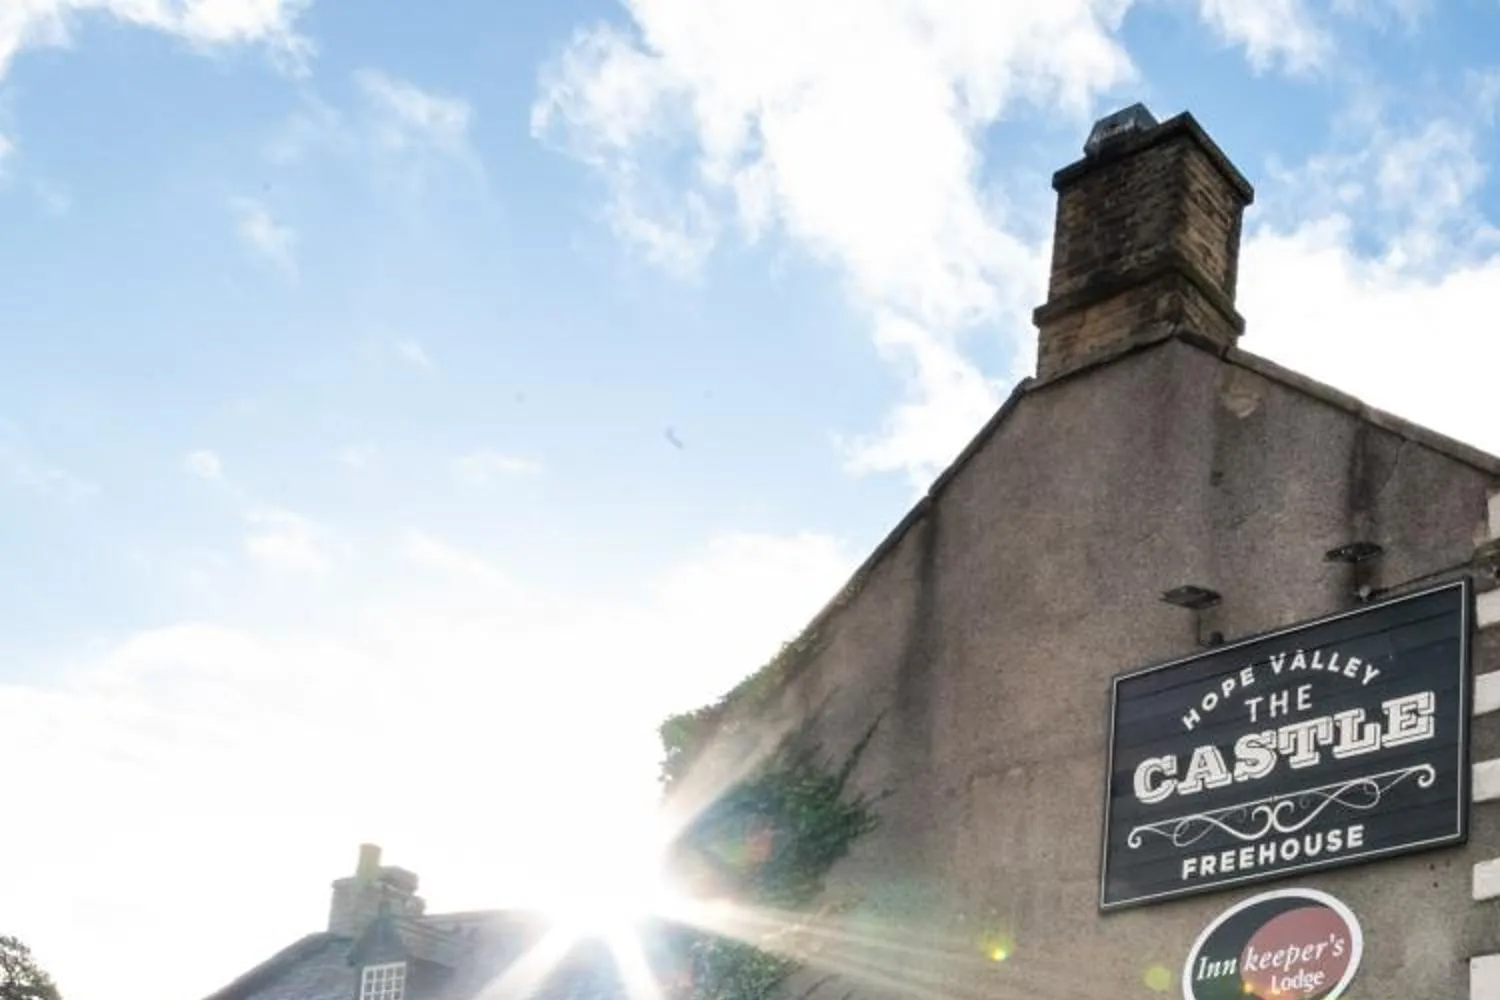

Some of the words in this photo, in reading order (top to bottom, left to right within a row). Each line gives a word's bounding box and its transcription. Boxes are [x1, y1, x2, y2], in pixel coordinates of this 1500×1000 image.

[1181, 666, 1254, 731] HOPE
[1269, 649, 1381, 687] VALLEY
[1244, 684, 1313, 722] THE
[1133, 691, 1436, 804] CASTLE
[1181, 825, 1364, 880] FREEHOUSE
[1196, 956, 1237, 981] Inn
[1243, 933, 1345, 972] keeper's
[1271, 968, 1325, 994] Lodge
